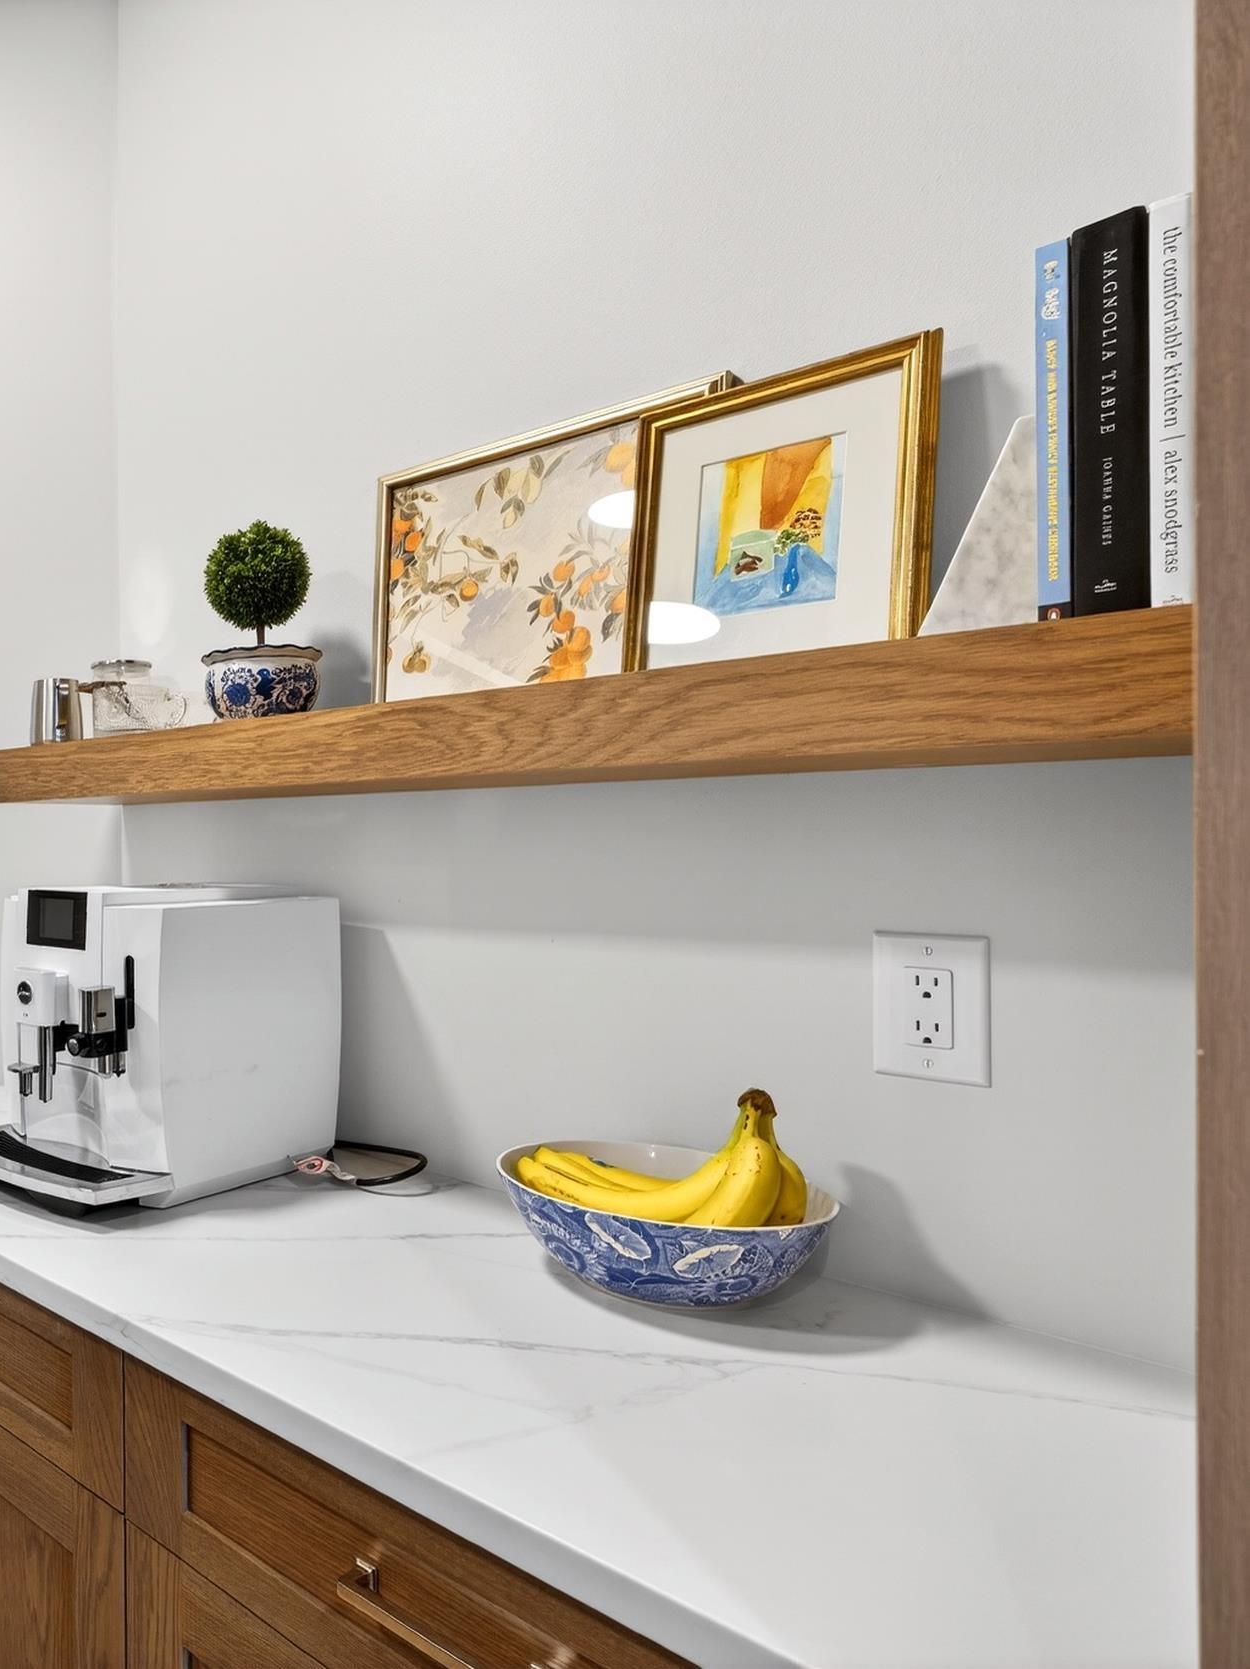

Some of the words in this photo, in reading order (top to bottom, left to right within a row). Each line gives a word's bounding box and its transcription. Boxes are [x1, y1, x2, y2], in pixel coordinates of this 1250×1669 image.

[1162, 226, 1183, 254] the
[1102, 248, 1118, 361] MAGNOLIA
[1162, 258, 1183, 360] comfortable
[1100, 369, 1117, 435] TABLE
[1162, 362, 1183, 428] kitchen
[1163, 450, 1183, 485] alex
[1160, 489, 1183, 574] snodgrass
